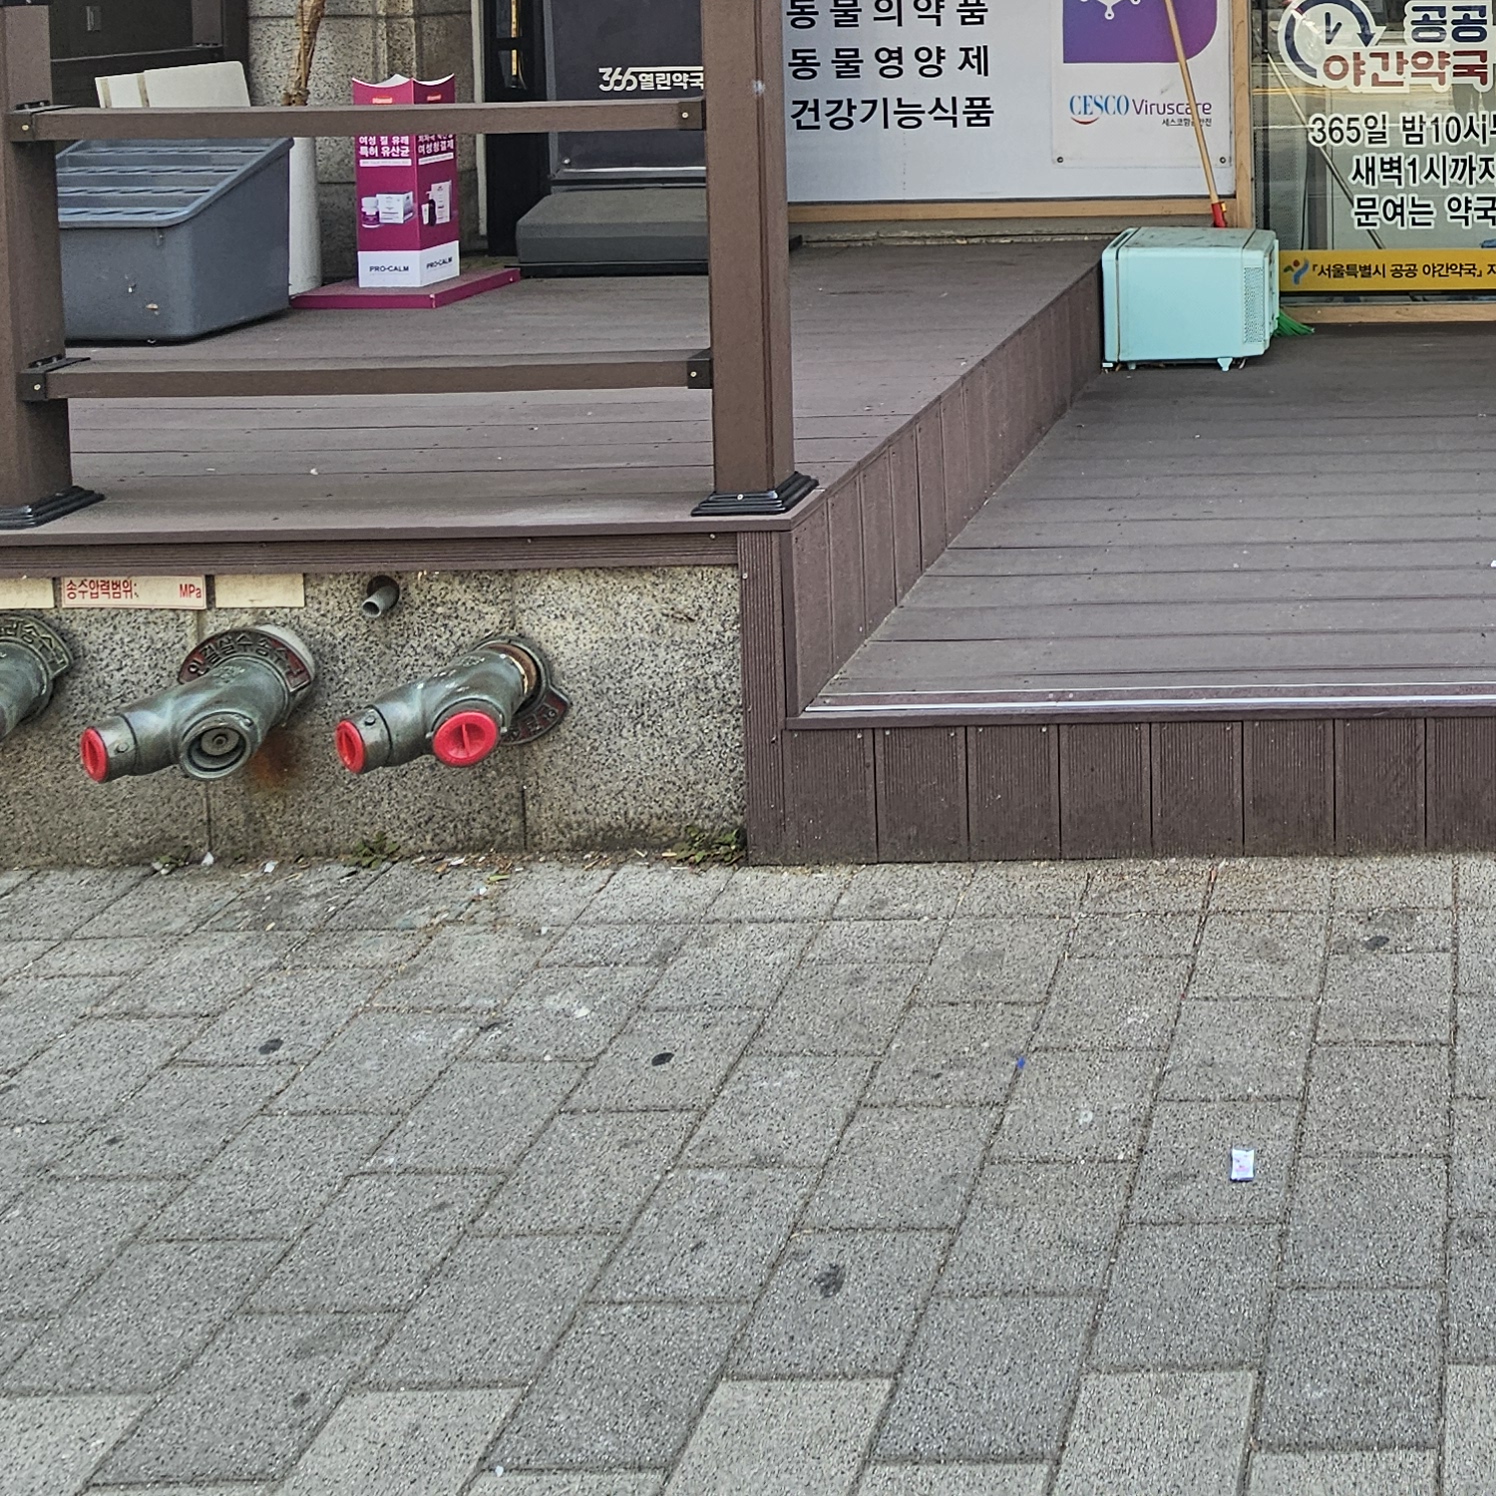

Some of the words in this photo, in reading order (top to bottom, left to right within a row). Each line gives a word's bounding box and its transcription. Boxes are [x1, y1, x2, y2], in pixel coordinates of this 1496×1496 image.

[1410, 4, 1490, 42] 공공
[787, 44, 992, 80] 동물영양제
[1322, 47, 1490, 88] 야간약국
[790, 96, 995, 132] 건강기능식품
[1069, 94, 1130, 116] CESCO
[1308, 112, 1390, 147] 365일
[381, 146, 410, 157] 유산균
[1354, 194, 1436, 229] 문여는
[369, 265, 409, 273] PRO-CALM
[1390, 260, 1418, 280] 공공
[179, 583, 202, 599] MPa
